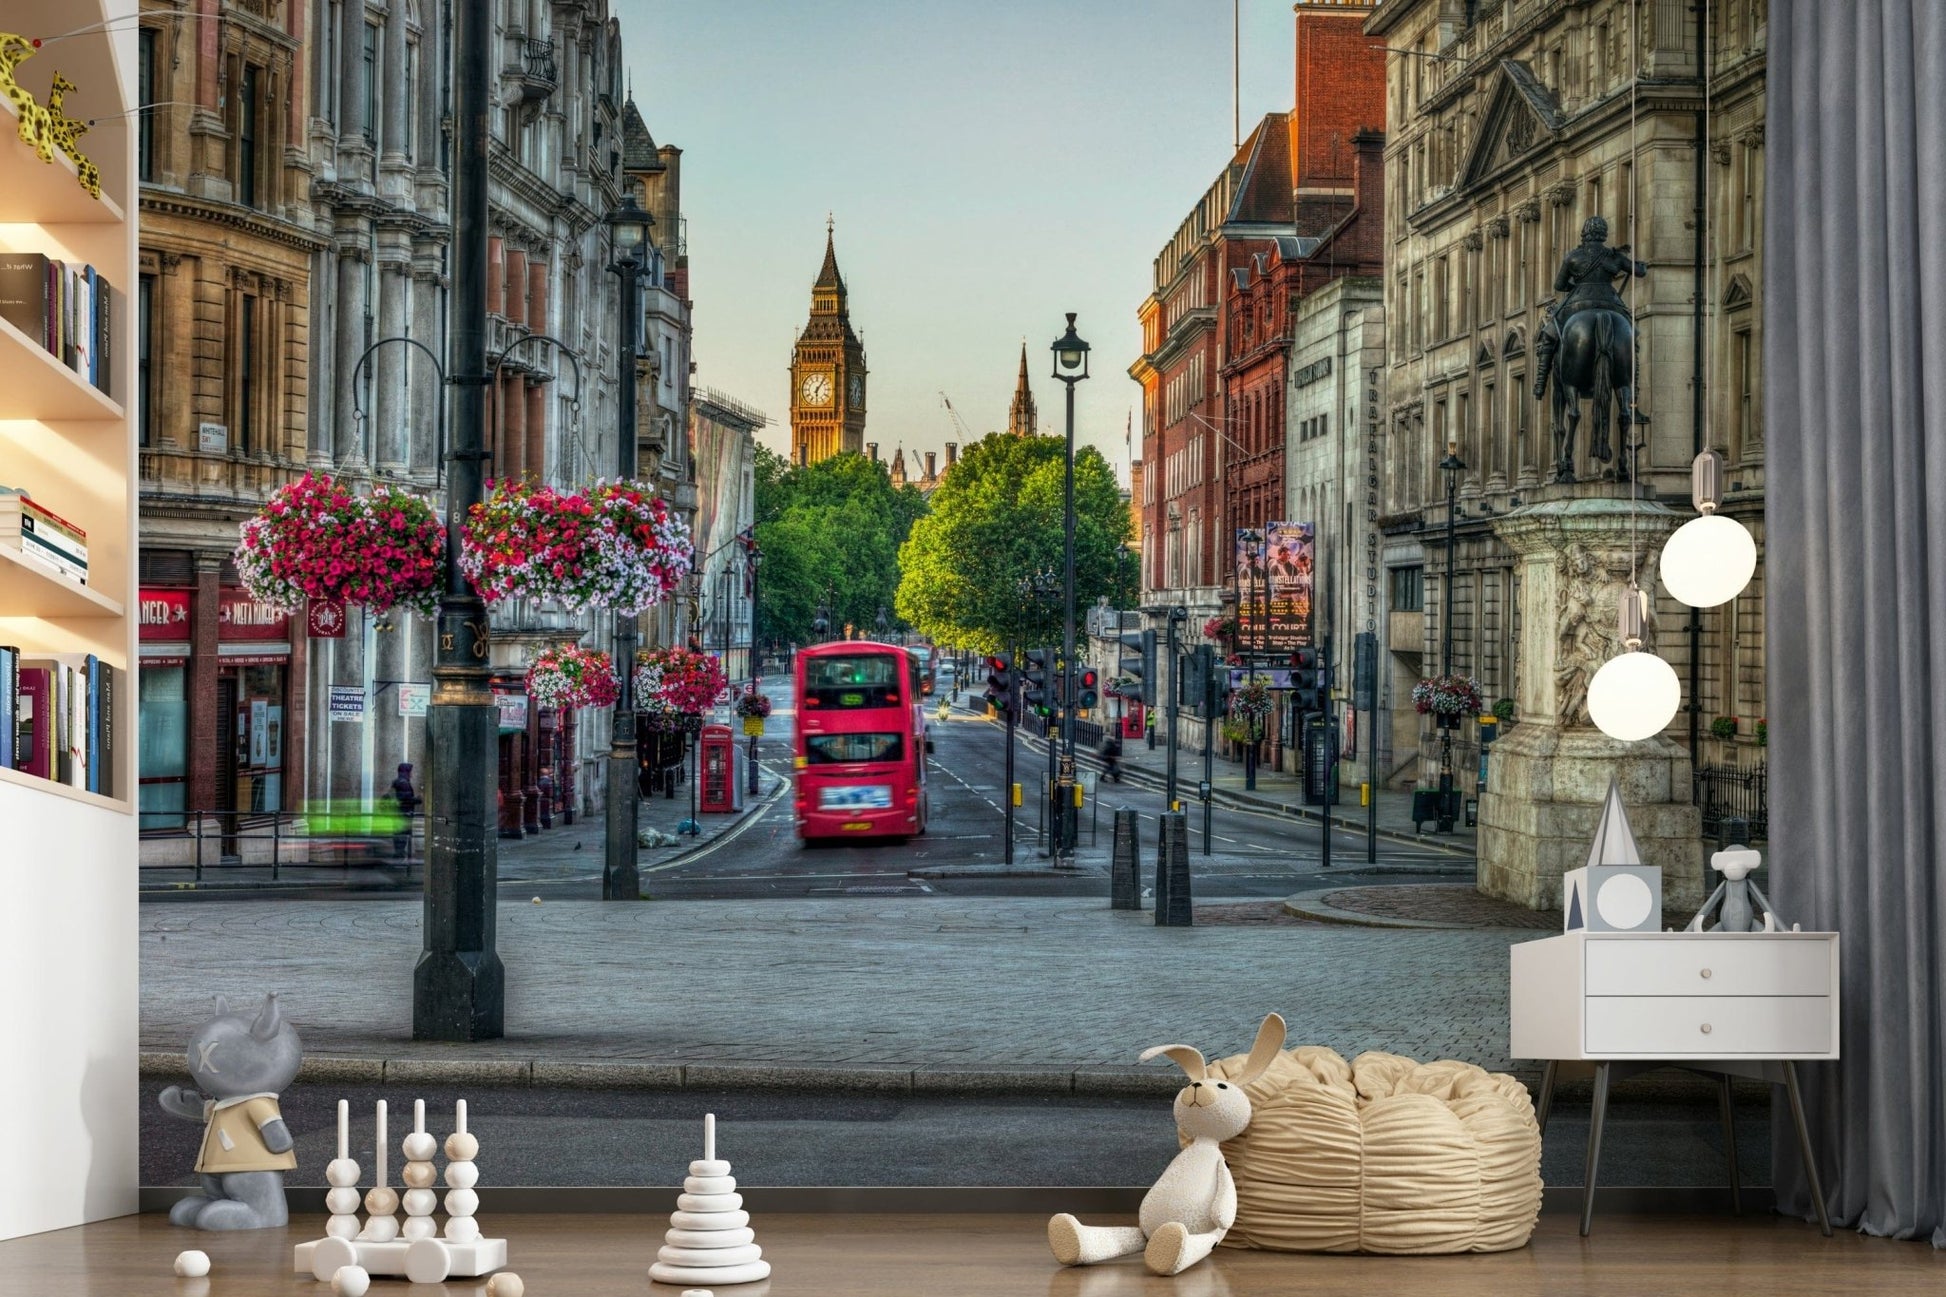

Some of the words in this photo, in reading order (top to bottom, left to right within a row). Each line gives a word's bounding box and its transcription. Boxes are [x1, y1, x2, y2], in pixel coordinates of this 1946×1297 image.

[1367, 371, 1378, 521] TRAFALGAR
[139, 600, 170, 624] NGER
[1366, 533, 1377, 631] STUDIO
